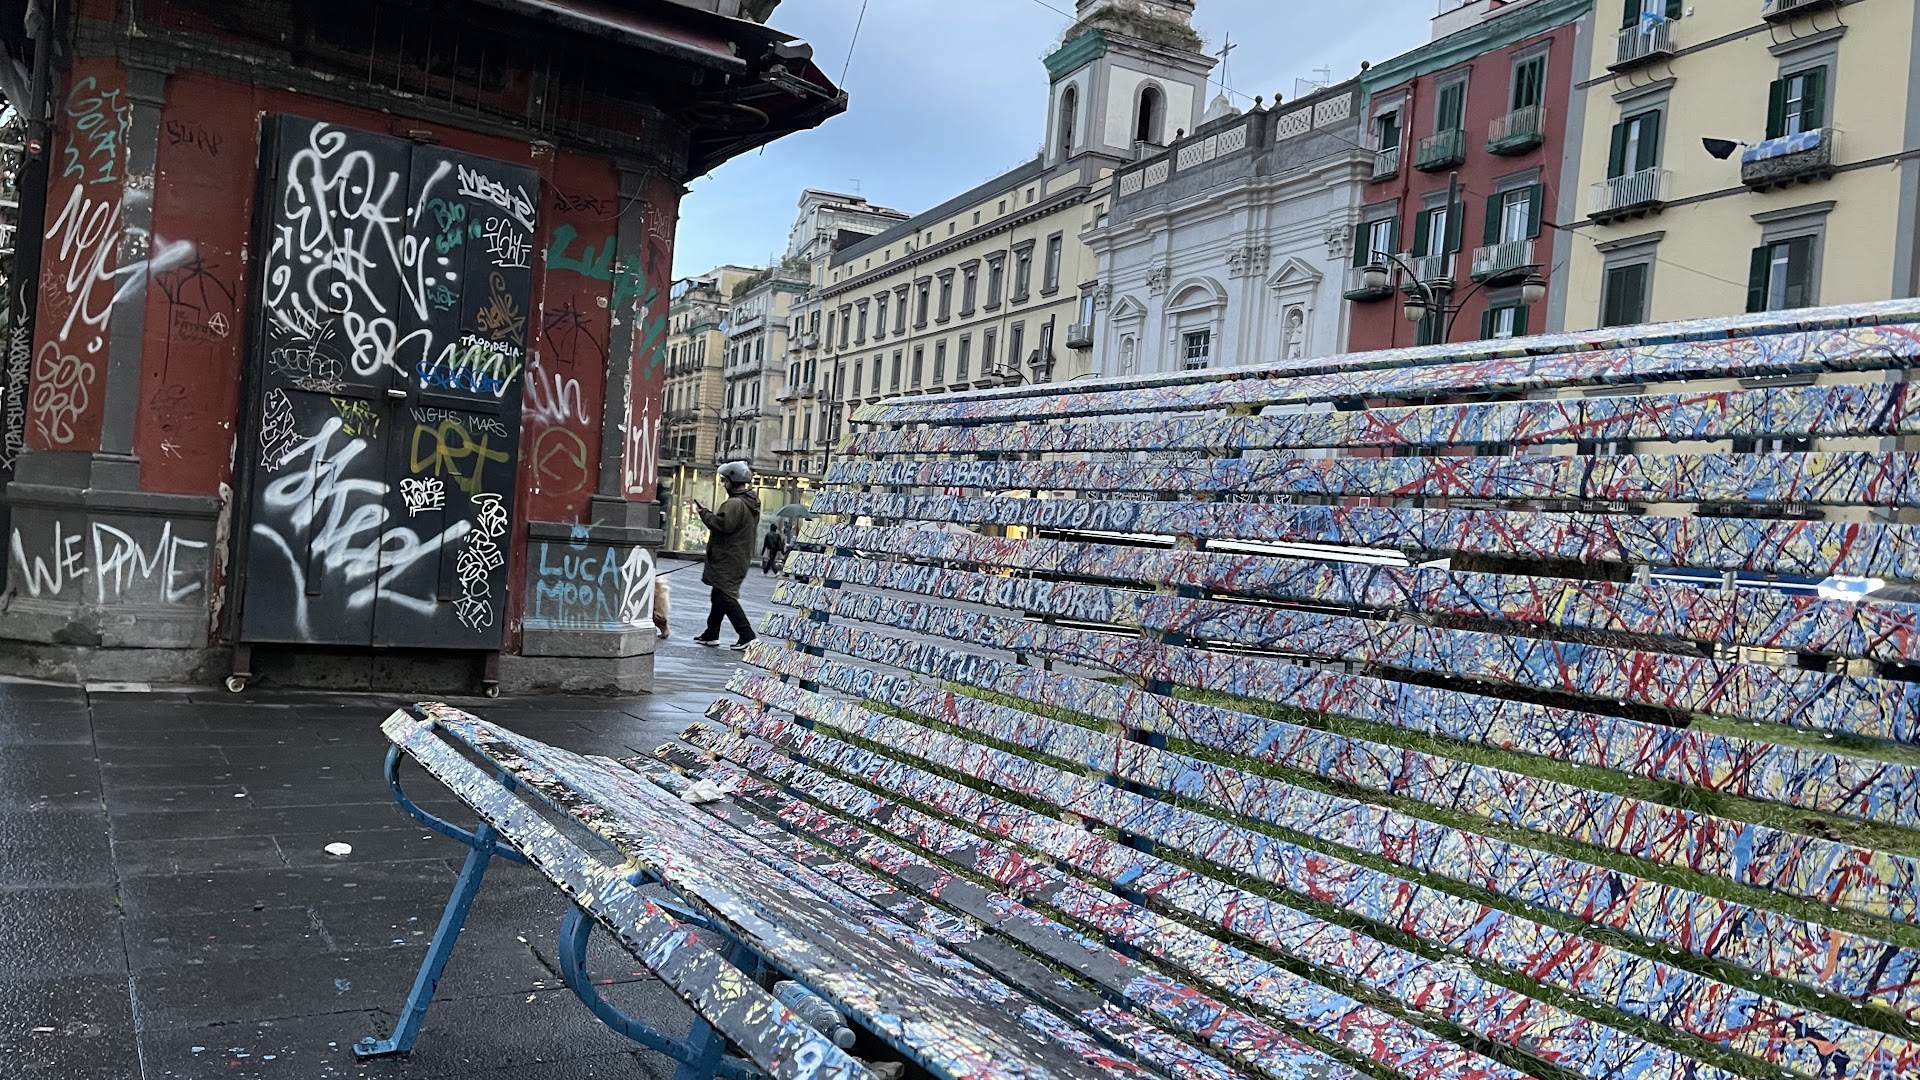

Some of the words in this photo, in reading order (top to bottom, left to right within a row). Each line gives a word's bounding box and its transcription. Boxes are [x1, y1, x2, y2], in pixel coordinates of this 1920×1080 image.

[468, 415, 508, 438] MARS
[928, 461, 1012, 488] LABBRA
[539, 542, 619, 590] LUCA
